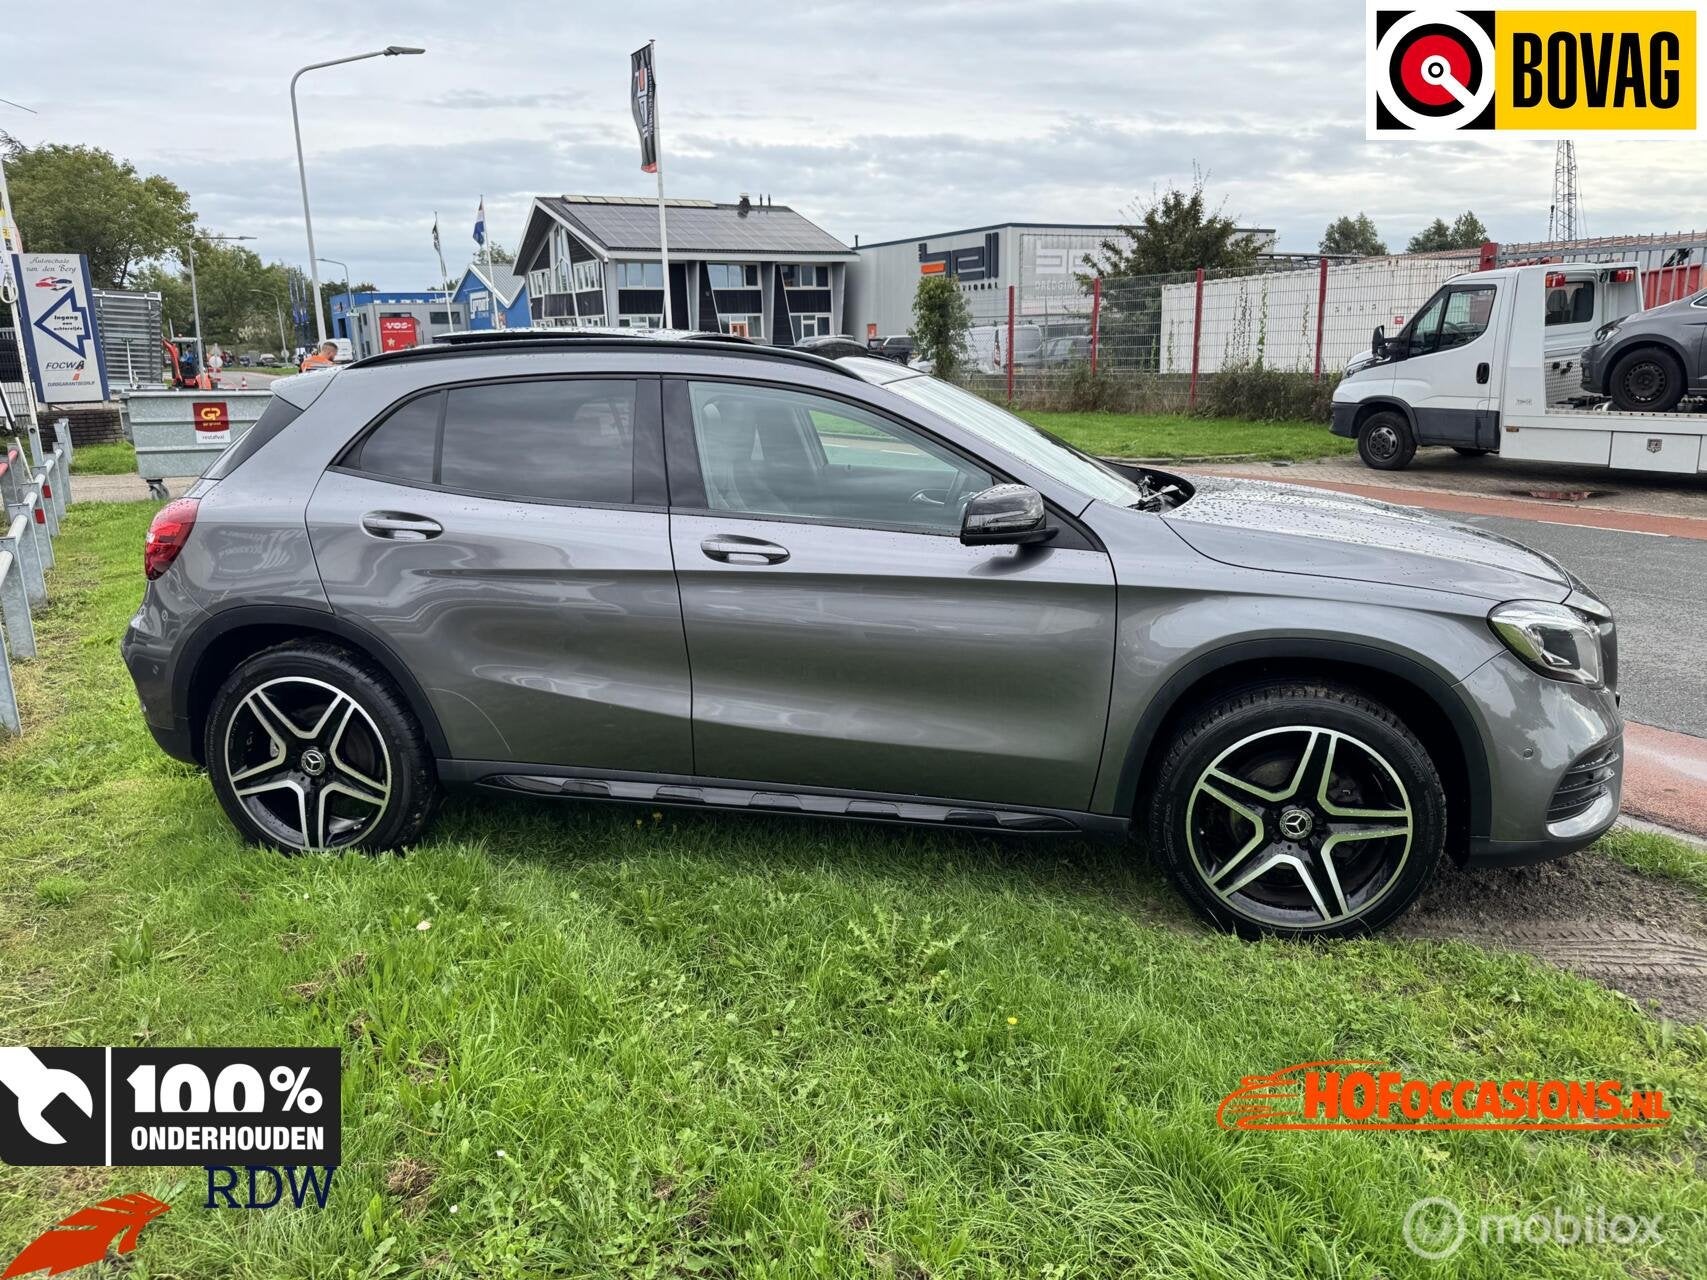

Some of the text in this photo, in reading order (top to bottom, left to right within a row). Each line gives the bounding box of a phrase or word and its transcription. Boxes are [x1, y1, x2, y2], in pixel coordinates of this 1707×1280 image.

[59, 265, 77, 274] Berg
[386, 322, 408, 330] VOS
[45, 360, 85, 370] FOCWA
